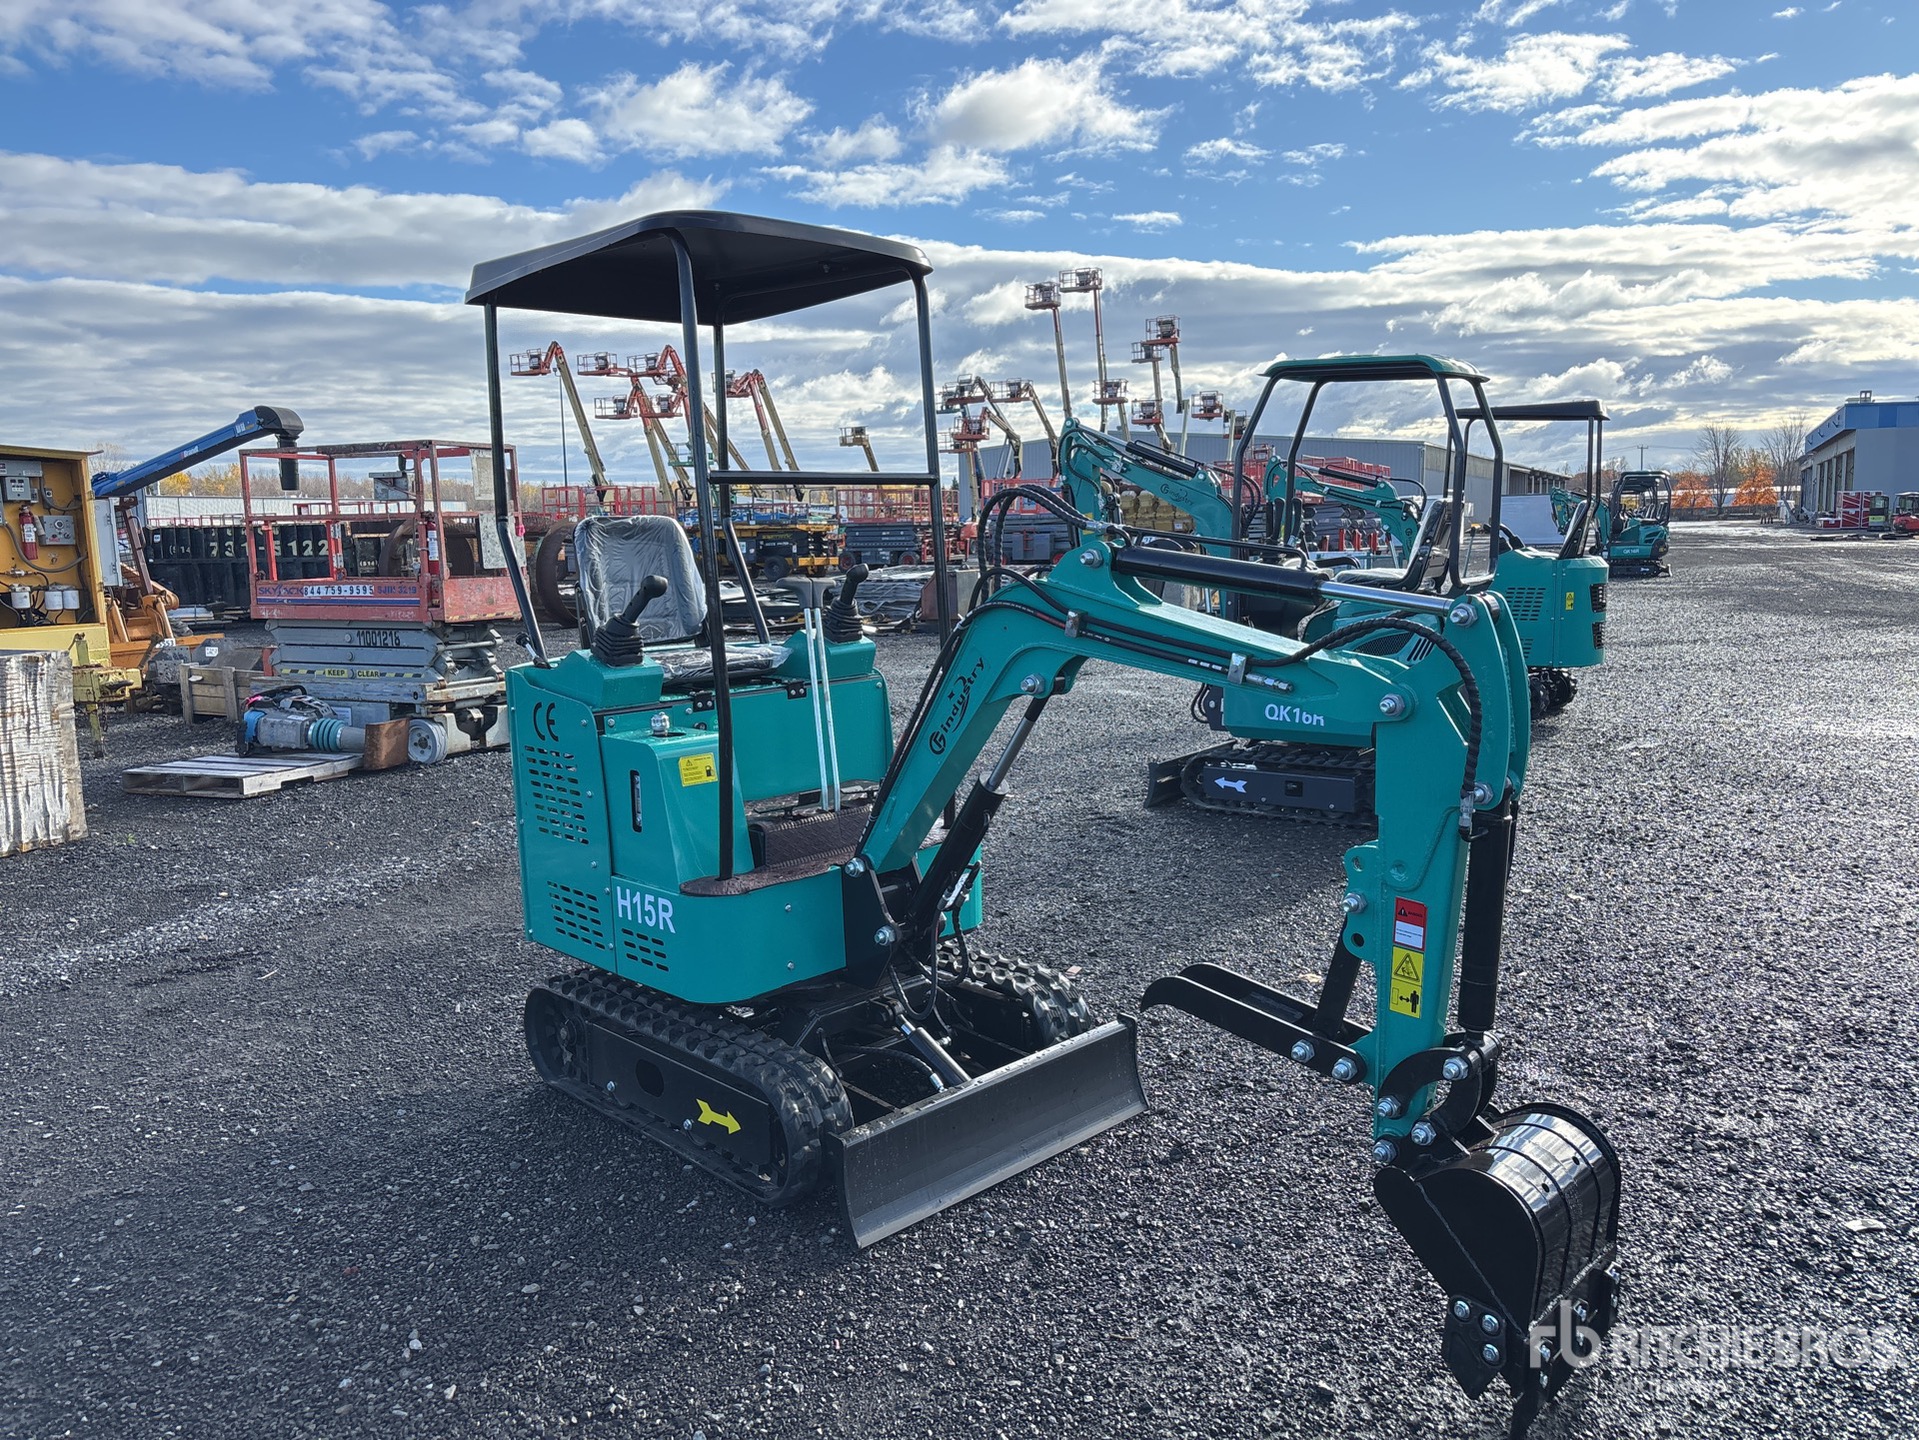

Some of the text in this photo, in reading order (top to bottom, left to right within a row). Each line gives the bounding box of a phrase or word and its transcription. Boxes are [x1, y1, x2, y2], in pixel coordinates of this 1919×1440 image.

[325, 585, 374, 595] 759-9595
[356, 630, 401, 646] 11001218
[327, 668, 380, 679] KEEP CLEAR
[533, 701, 559, 742] CE
[616, 885, 676, 934] H15R
